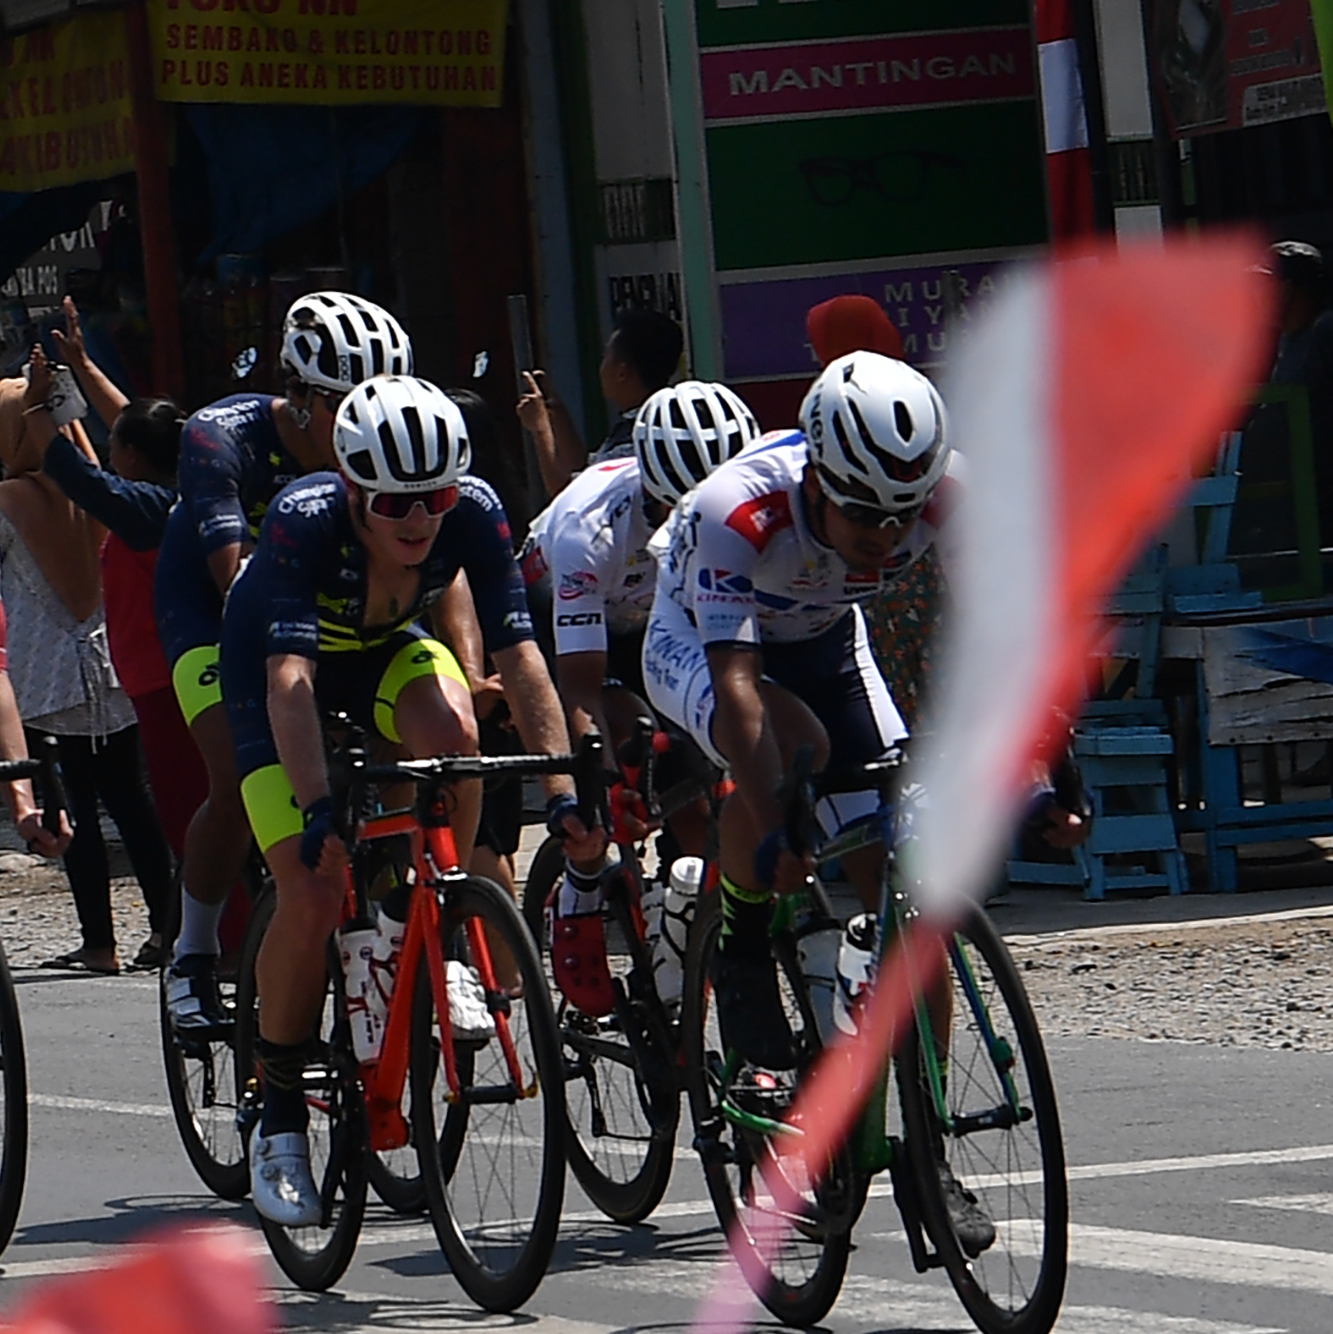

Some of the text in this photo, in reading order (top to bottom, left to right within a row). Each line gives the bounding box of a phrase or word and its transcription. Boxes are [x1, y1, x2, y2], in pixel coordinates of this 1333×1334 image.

[166, 23, 491, 55] SEMBAKO & KELONTONG
[161, 58, 496, 91] PLUS ANEKA KEBUTUHAN
[728, 53, 1016, 96] MANTINGAN
